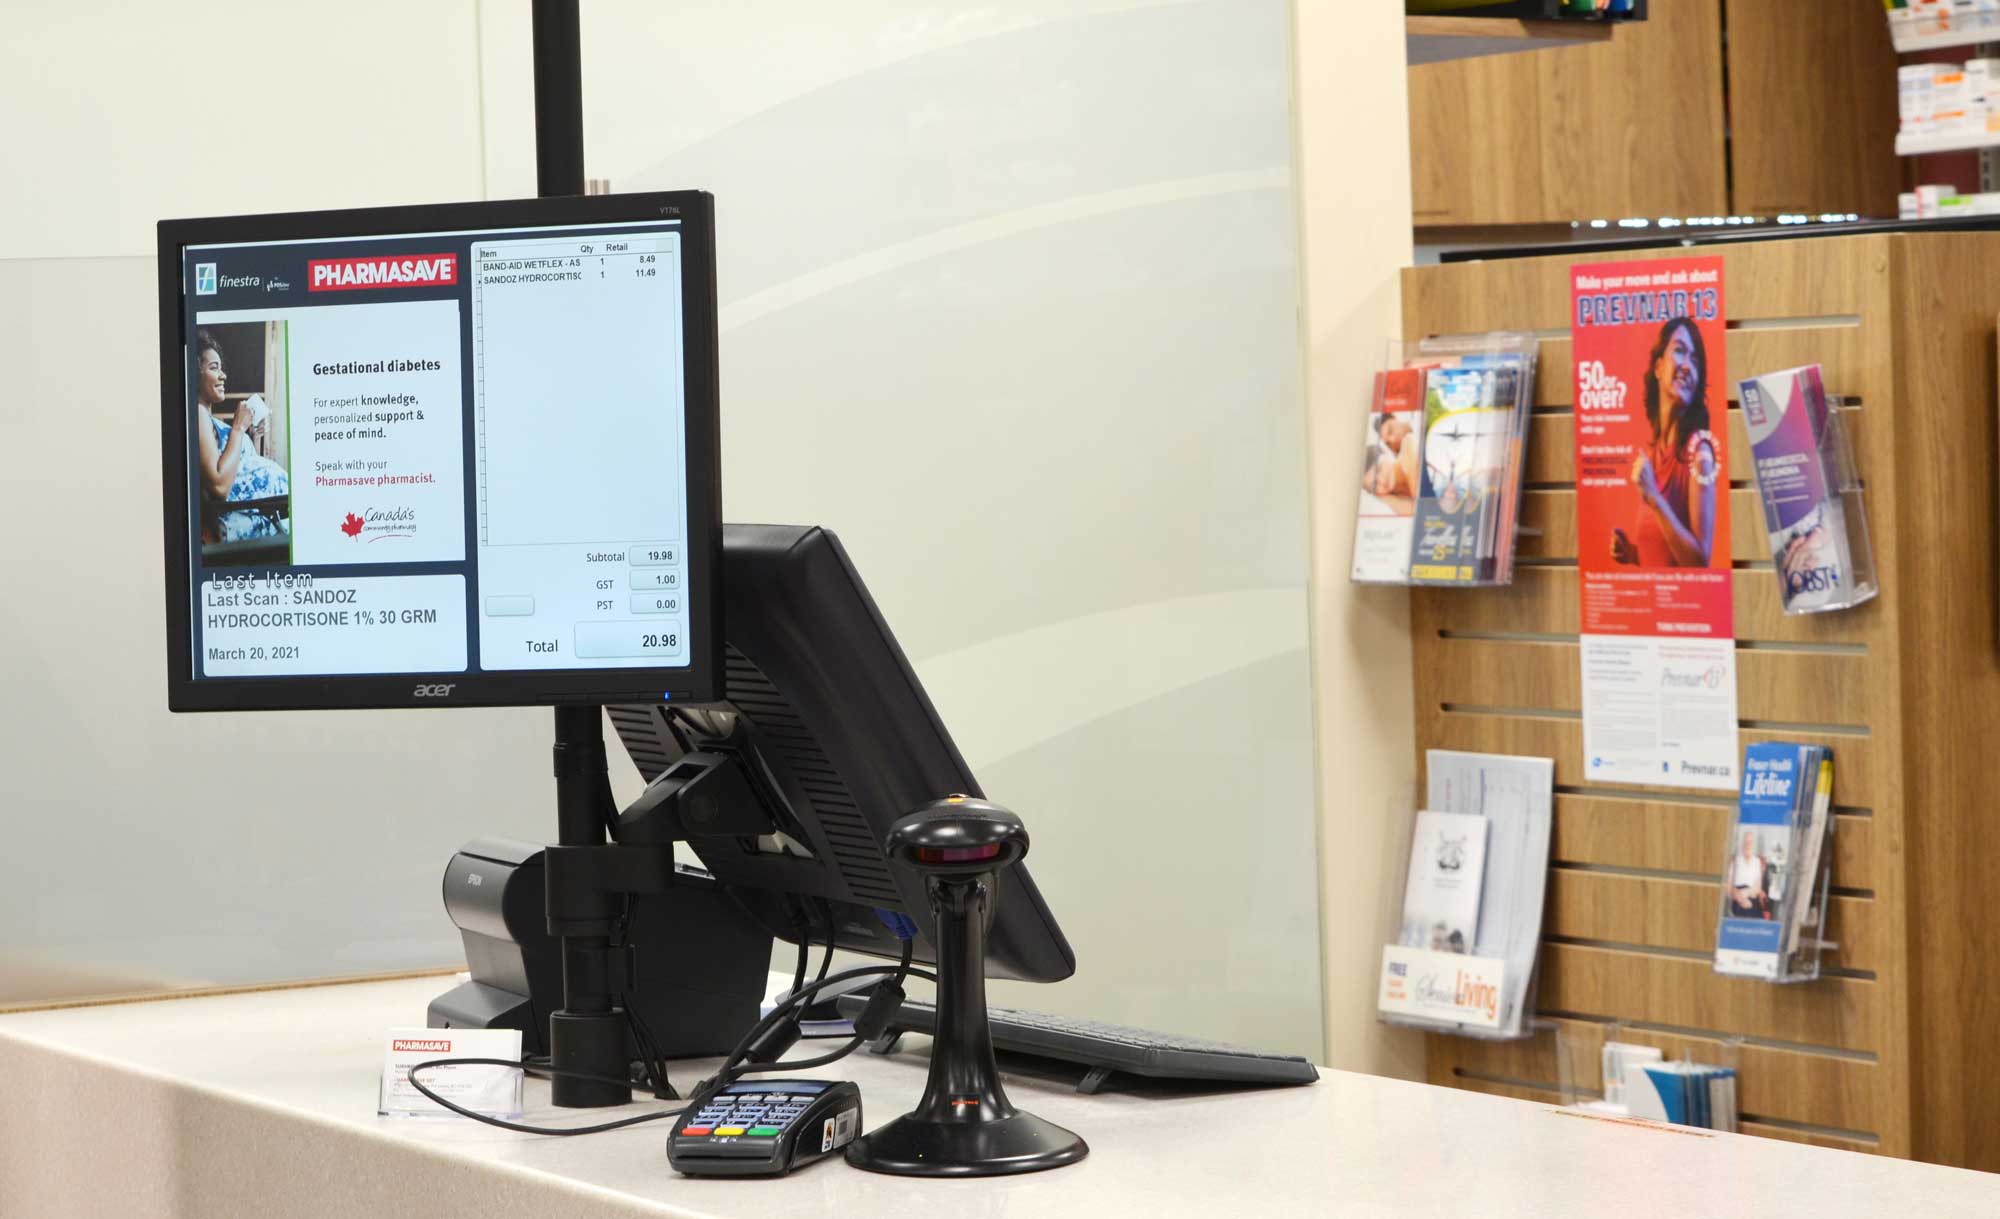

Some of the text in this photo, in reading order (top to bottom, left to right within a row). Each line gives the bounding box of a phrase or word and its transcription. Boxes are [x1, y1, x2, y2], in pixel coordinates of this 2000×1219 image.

[481, 243, 628, 258] Item Qty Retail
[483, 261, 522, 271] BAND-AID
[524, 260, 563, 269] WETFLEX
[600, 257, 605, 265] 1
[639, 255, 656, 263] 8.49
[313, 258, 452, 287] PHARMASAVE
[484, 275, 517, 284] SANDOZ
[600, 271, 605, 279] 1
[635, 269, 656, 277] 11.49
[1602, 276, 1624, 290] your
[1625, 275, 1650, 286] move
[1652, 271, 1670, 285] and
[1671, 270, 1688, 284] ask
[1689, 269, 1717, 283] about
[219, 275, 260, 288] finestra
[1578, 287, 1718, 327] PREVNAR 13
[313, 359, 441, 375] Gestational diabetes
[1578, 361, 1605, 391] 50
[314, 393, 419, 408] For expert knowledge,
[1580, 381, 1627, 409] over?
[314, 410, 425, 426] personalized support &
[314, 427, 387, 443] peace of mind.
[315, 459, 388, 473] Speak with your
[315, 472, 436, 487] Pharmasave pharmacist.
[364, 506, 415, 523] Canada's
[586, 551, 673, 562] Subtotal 19.98
[212, 570, 313, 591] Last Item
[596, 575, 675, 590] GST 1.00
[207, 593, 239, 607] Last
[243, 592, 279, 606] Scan
[292, 590, 357, 605] SANDOZ
[597, 600, 676, 610] PST 0.00
[208, 609, 437, 628] HYDROCORTISONE 1% 30 GRM
[526, 634, 677, 653] Total 20.98
[208, 646, 300, 661] March 20, 2021
[413, 684, 456, 697] acer
[394, 1040, 450, 1051] PHARMASAVE
